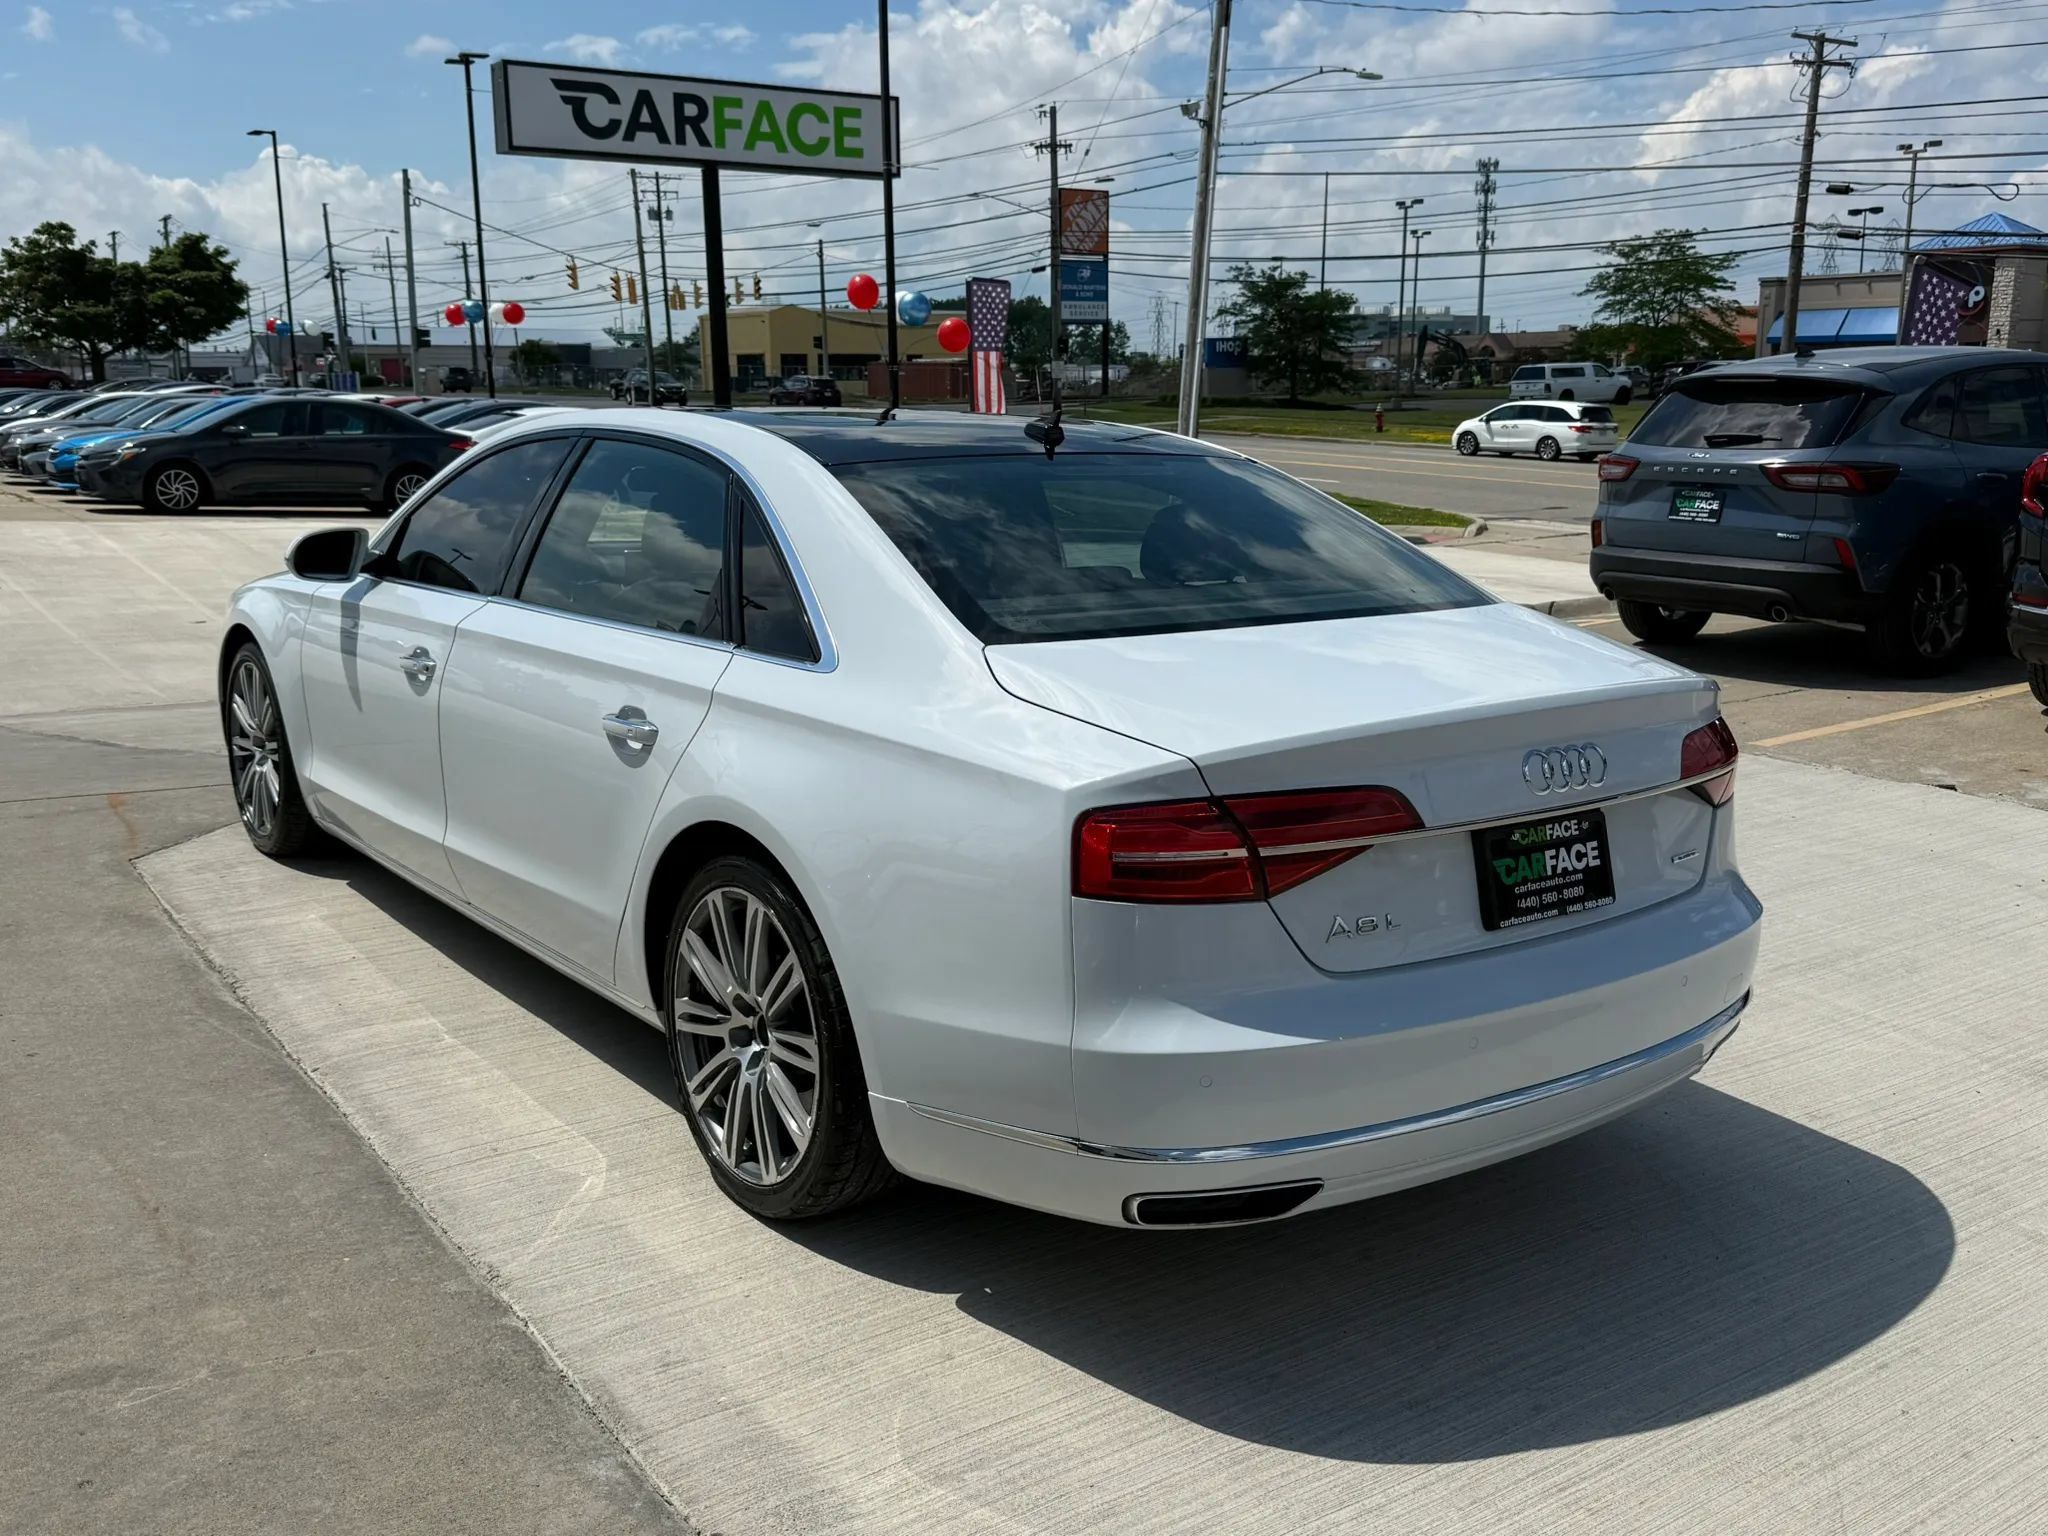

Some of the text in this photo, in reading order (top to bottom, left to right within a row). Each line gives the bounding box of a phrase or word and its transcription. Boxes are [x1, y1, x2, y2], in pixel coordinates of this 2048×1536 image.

[549, 77, 865, 160] CARFACE
[1653, 466, 1738, 476] ESCAPE
[1676, 499, 1720, 510] CARFACE
[1515, 819, 1580, 845] CARFACE
[1492, 841, 1601, 885] CARFACE
[1514, 872, 1583, 894] carfaceauto.com
[1517, 893, 1540, 909] (440)
[1500, 907, 1559, 928] carfaceauto.com
[1566, 902, 1584, 915] (440)
